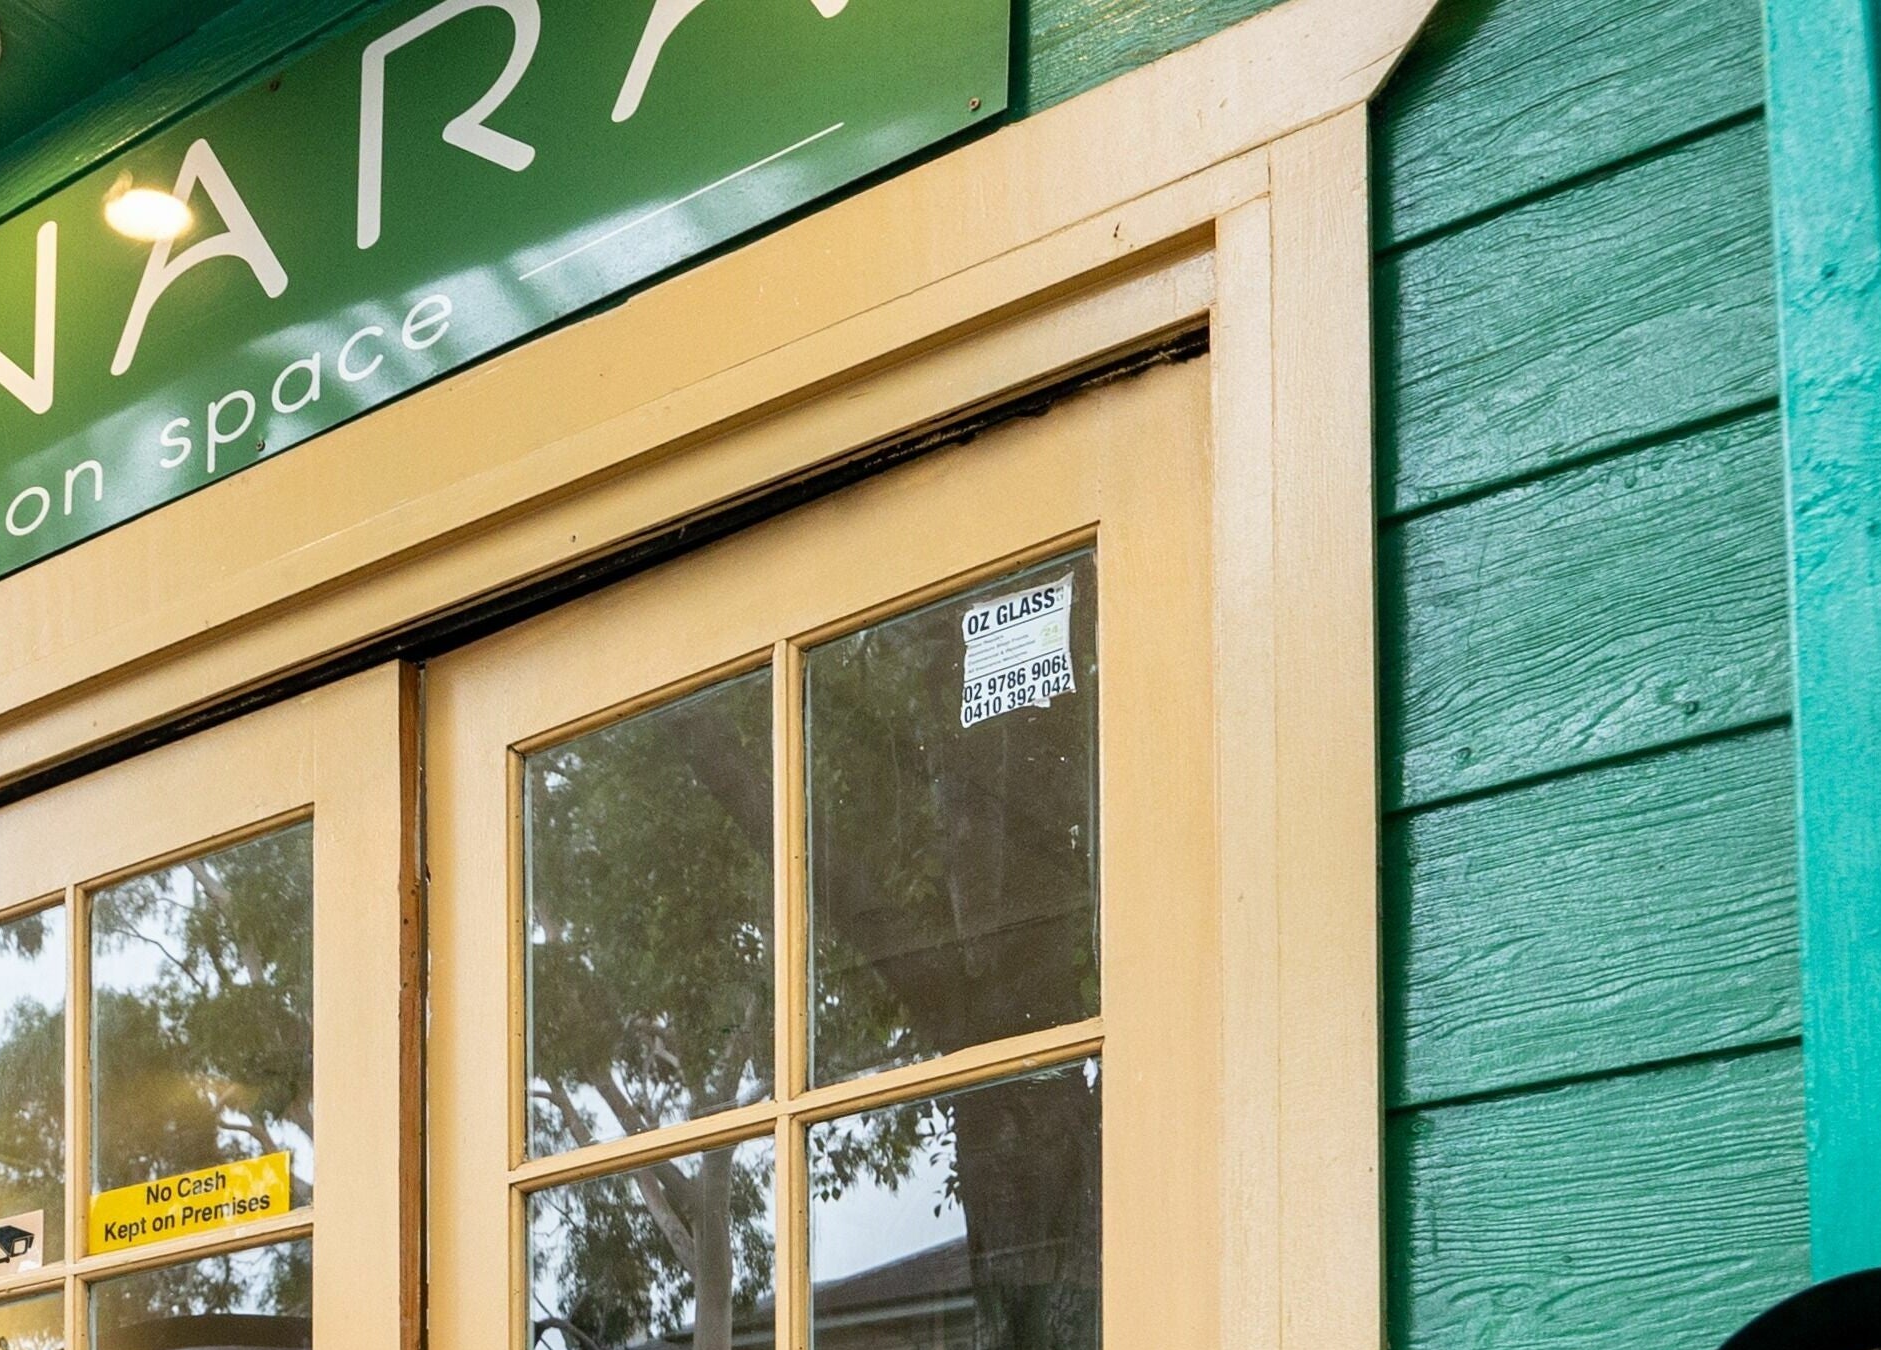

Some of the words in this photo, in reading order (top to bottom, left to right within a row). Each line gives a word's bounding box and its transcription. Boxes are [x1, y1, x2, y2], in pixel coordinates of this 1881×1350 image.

[159, 294, 454, 474] space
[967, 610, 990, 635] OZ
[996, 587, 1055, 626] GLASS
[963, 682, 982, 704] 02
[987, 667, 1026, 696] 9786
[964, 696, 1002, 723] 0410
[1007, 684, 1036, 709] 392
[1041, 673, 1071, 698] 042
[145, 1183, 172, 1206] No
[177, 1171, 226, 1199] Cash
[104, 1216, 146, 1243] Kept
[152, 1213, 175, 1232] on
[181, 1193, 271, 1227] Premises
